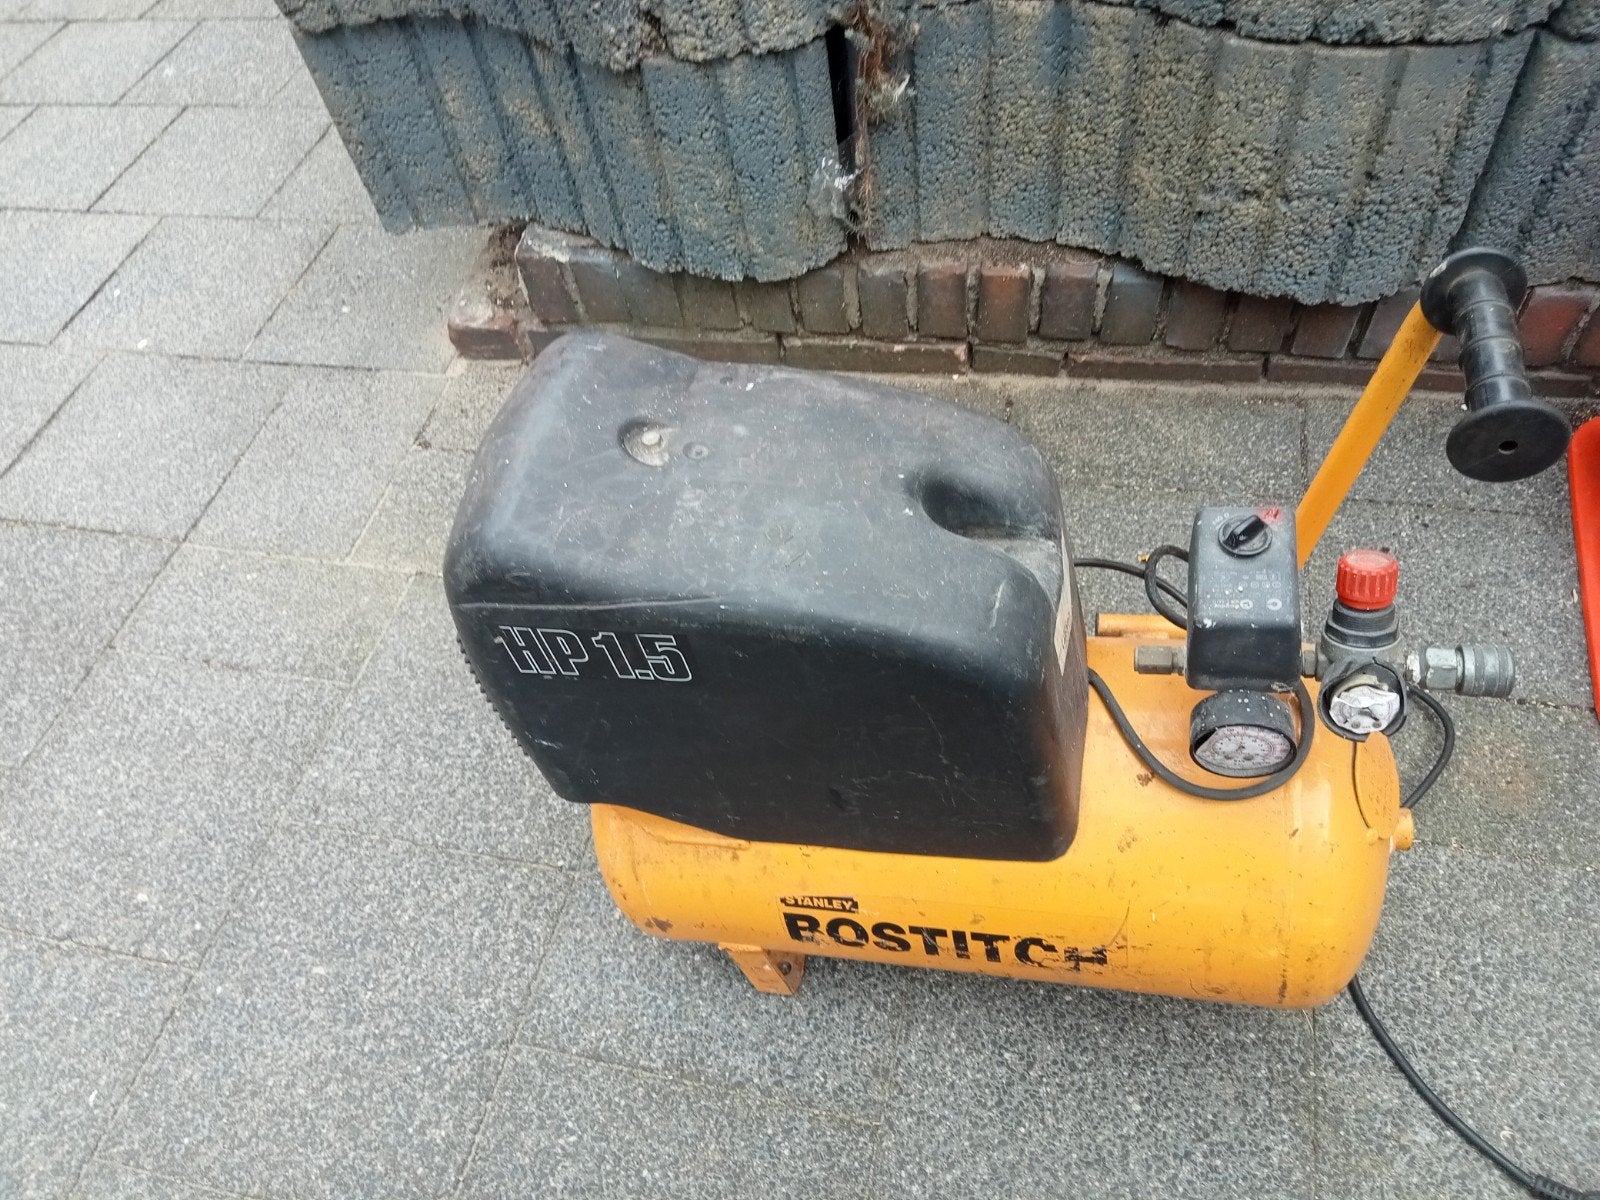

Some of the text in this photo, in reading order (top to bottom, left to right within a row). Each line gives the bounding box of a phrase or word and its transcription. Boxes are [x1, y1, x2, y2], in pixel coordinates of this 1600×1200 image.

[497, 625, 693, 682] HP 1.5
[783, 895, 854, 911] STANLEY
